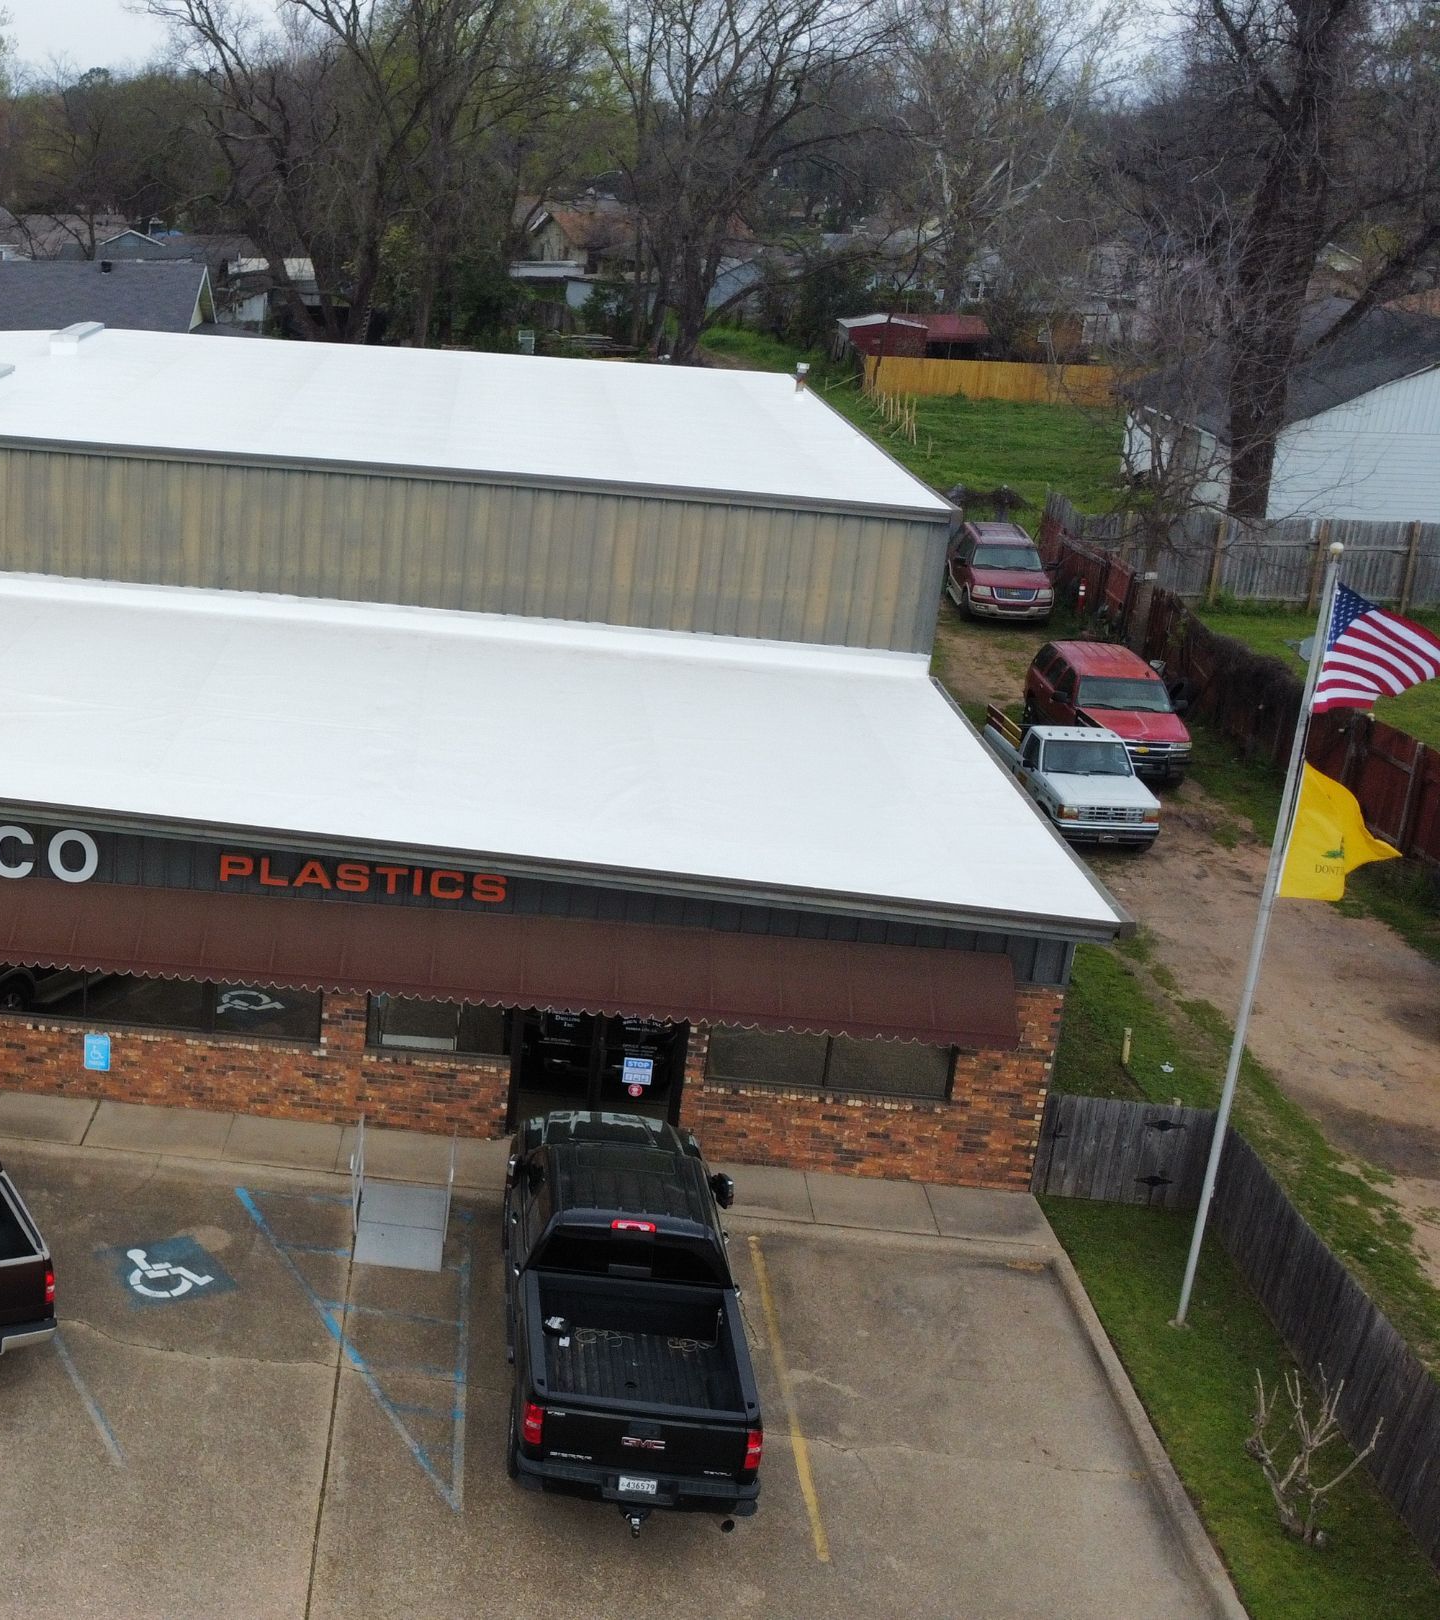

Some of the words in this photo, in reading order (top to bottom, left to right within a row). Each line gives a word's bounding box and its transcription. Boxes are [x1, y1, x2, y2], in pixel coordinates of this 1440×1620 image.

[219, 853, 508, 904] PLASTICS
[627, 1060, 650, 1069] STOP
[621, 1436, 666, 1450] GMC
